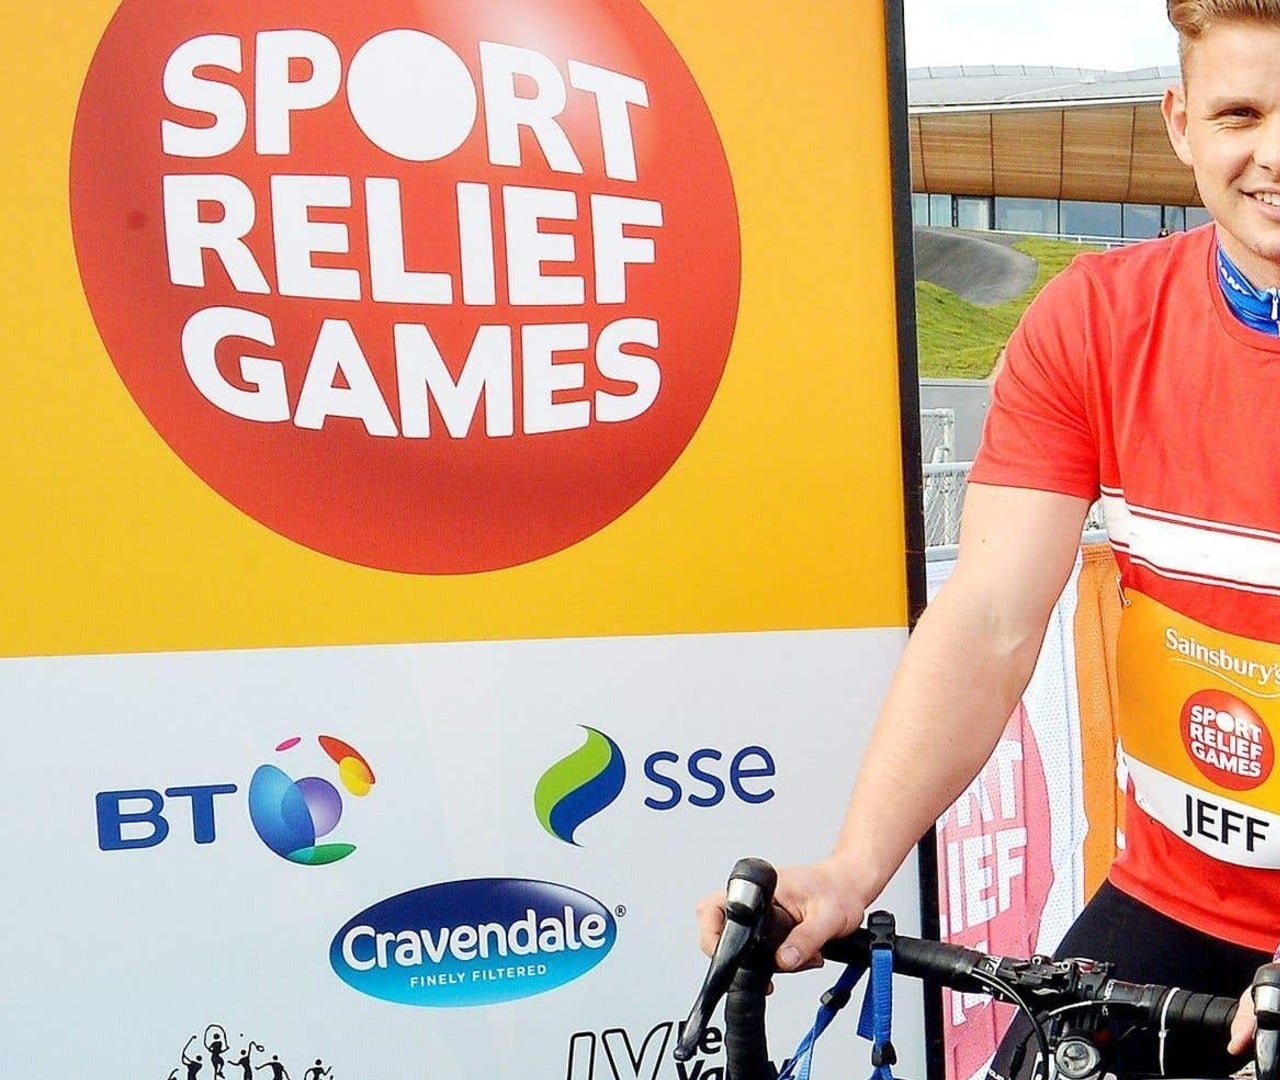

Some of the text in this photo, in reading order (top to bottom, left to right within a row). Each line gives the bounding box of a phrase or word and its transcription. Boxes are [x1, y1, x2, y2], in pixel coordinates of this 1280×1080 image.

[161, 28, 649, 182] SPORT
[163, 174, 663, 305] RELIEF
[181, 306, 661, 438] GAMES
[1189, 722, 1264, 761] RELIEF
[1190, 705, 1263, 744] SPORT
[644, 745, 776, 810] sse
[1190, 740, 1262, 778] GAMES
[96, 782, 238, 851] BT
[1183, 794, 1269, 852] JEFF
[342, 905, 606, 970] Cravendale
[410, 965, 547, 988] FINELY FILTERED
